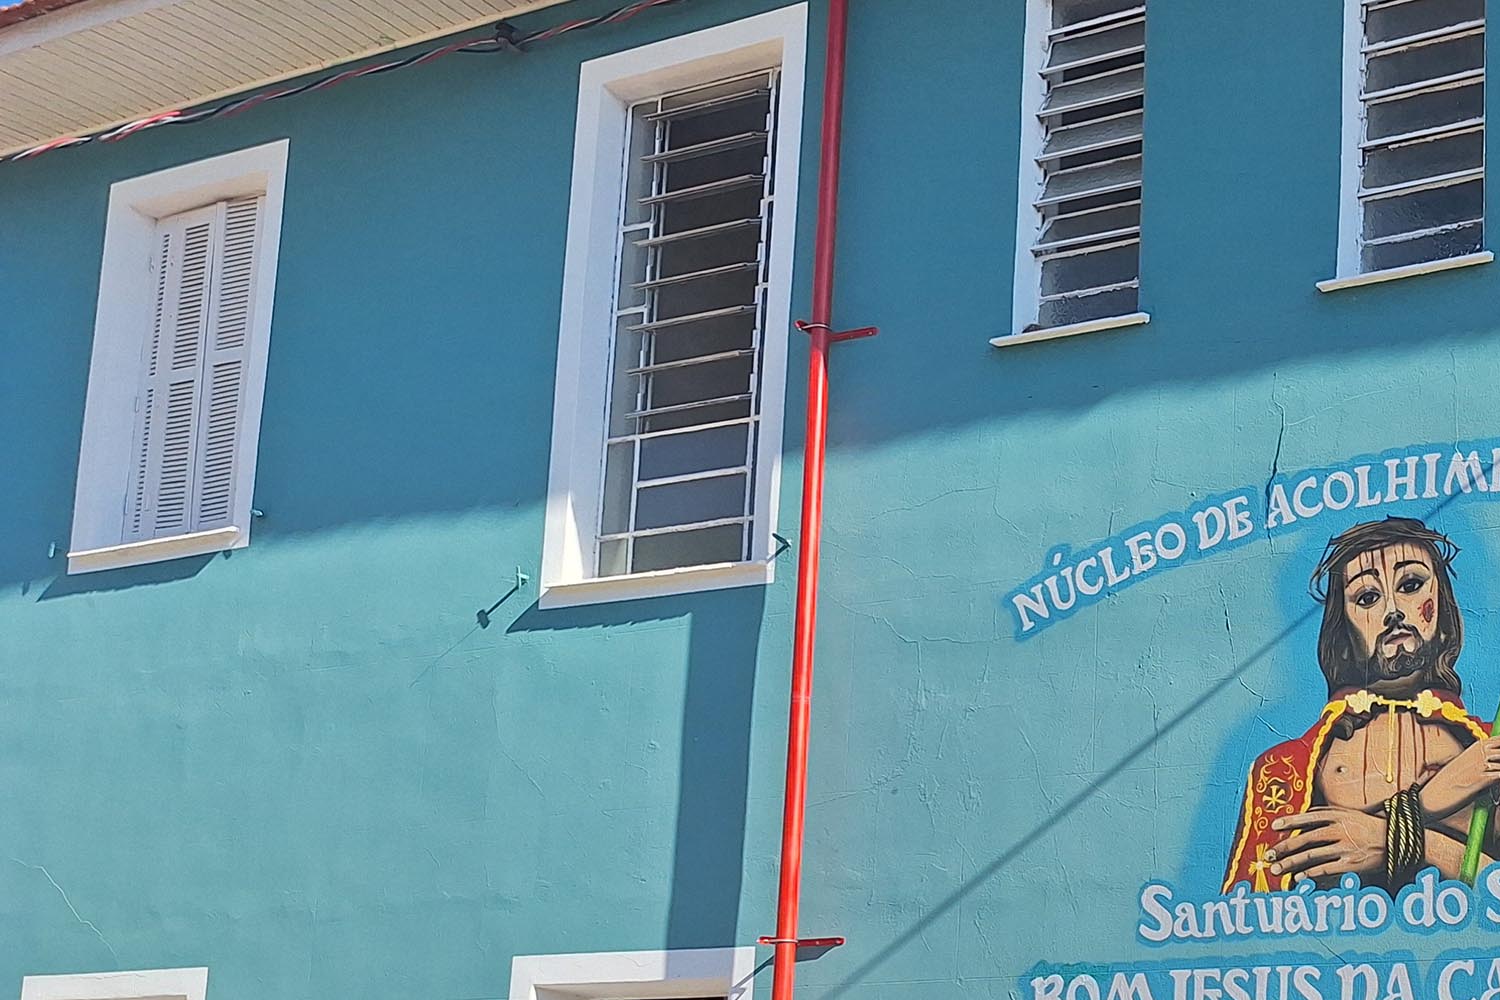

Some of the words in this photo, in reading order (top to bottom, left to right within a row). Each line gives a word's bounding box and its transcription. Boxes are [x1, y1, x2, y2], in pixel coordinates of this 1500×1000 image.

[1012, 523, 1187, 631] NÚCLEO
[1192, 497, 1253, 549] DE
[1139, 875, 1388, 942] Santuário
[1403, 868, 1468, 928] do
